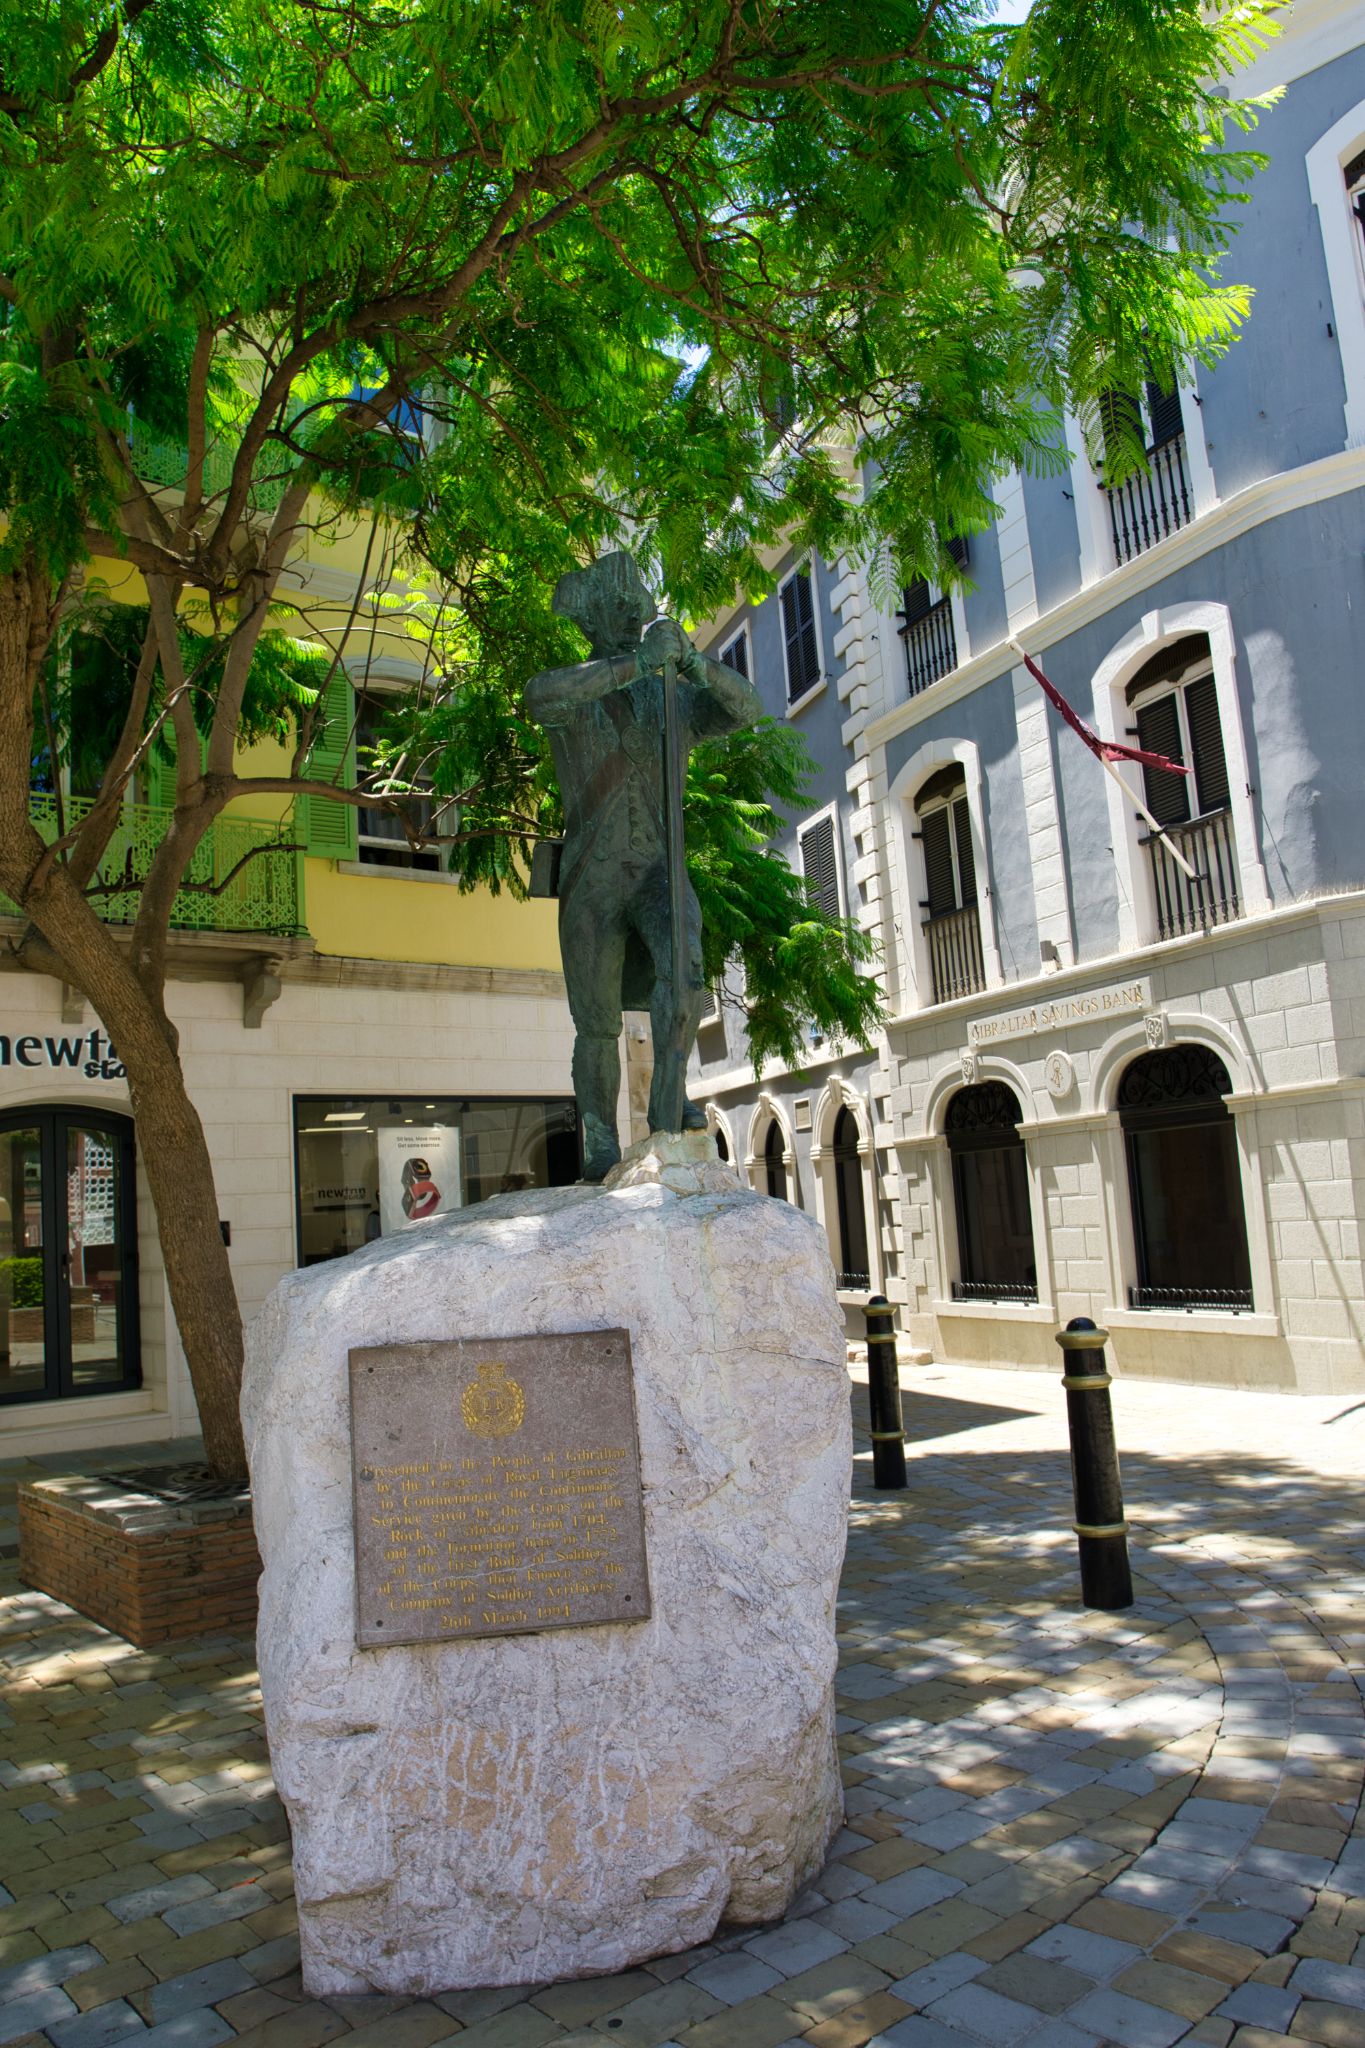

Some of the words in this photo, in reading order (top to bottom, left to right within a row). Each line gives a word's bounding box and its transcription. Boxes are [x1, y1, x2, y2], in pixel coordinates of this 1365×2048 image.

[972, 1012, 1039, 1040] GIBRALTAR
[1041, 997, 1099, 1024] SAVINGS
[1102, 986, 1144, 1010] BANK
[318, 1185, 366, 1198] newton
[363, 1461, 430, 1477] Presented
[462, 1458, 481, 1471] the
[491, 1453, 533, 1469] People
[543, 1450, 556, 1464] of
[566, 1447, 626, 1462] Gibraltar
[402, 1479, 421, 1492] the
[481, 1472, 493, 1486] of
[505, 1468, 540, 1484] Royal
[551, 1465, 618, 1480] Engineers
[380, 1498, 394, 1511] to
[403, 1490, 501, 1508] Commemorate
[510, 1486, 529, 1499] the
[540, 1481, 616, 1497] Continuous
[371, 1513, 422, 1528] Service
[432, 1510, 466, 1525] given
[475, 1505, 490, 1520] by
[501, 1503, 520, 1517] the
[530, 1500, 572, 1516] Corps
[580, 1499, 595, 1511] on
[604, 1495, 624, 1508] the
[390, 1527, 424, 1543] Rock
[434, 1526, 448, 1539] of
[532, 1517, 564, 1531] from
[383, 1545, 408, 1560] and
[417, 1543, 438, 1558] the
[562, 1532, 578, 1545] in
[392, 1562, 406, 1577] of
[417, 1562, 437, 1575] the
[488, 1551, 522, 1570] Body
[532, 1550, 546, 1565] of
[556, 1545, 609, 1562] Soldiers
[379, 1580, 394, 1595] of
[404, 1579, 424, 1593] the
[488, 1572, 517, 1586] then
[526, 1567, 572, 1582] known
[582, 1564, 598, 1577] as
[604, 1559, 624, 1574] the
[390, 1596, 452, 1612] Company
[463, 1590, 476, 1605] of
[487, 1586, 533, 1602] Soldier
[482, 1607, 528, 1626] March
